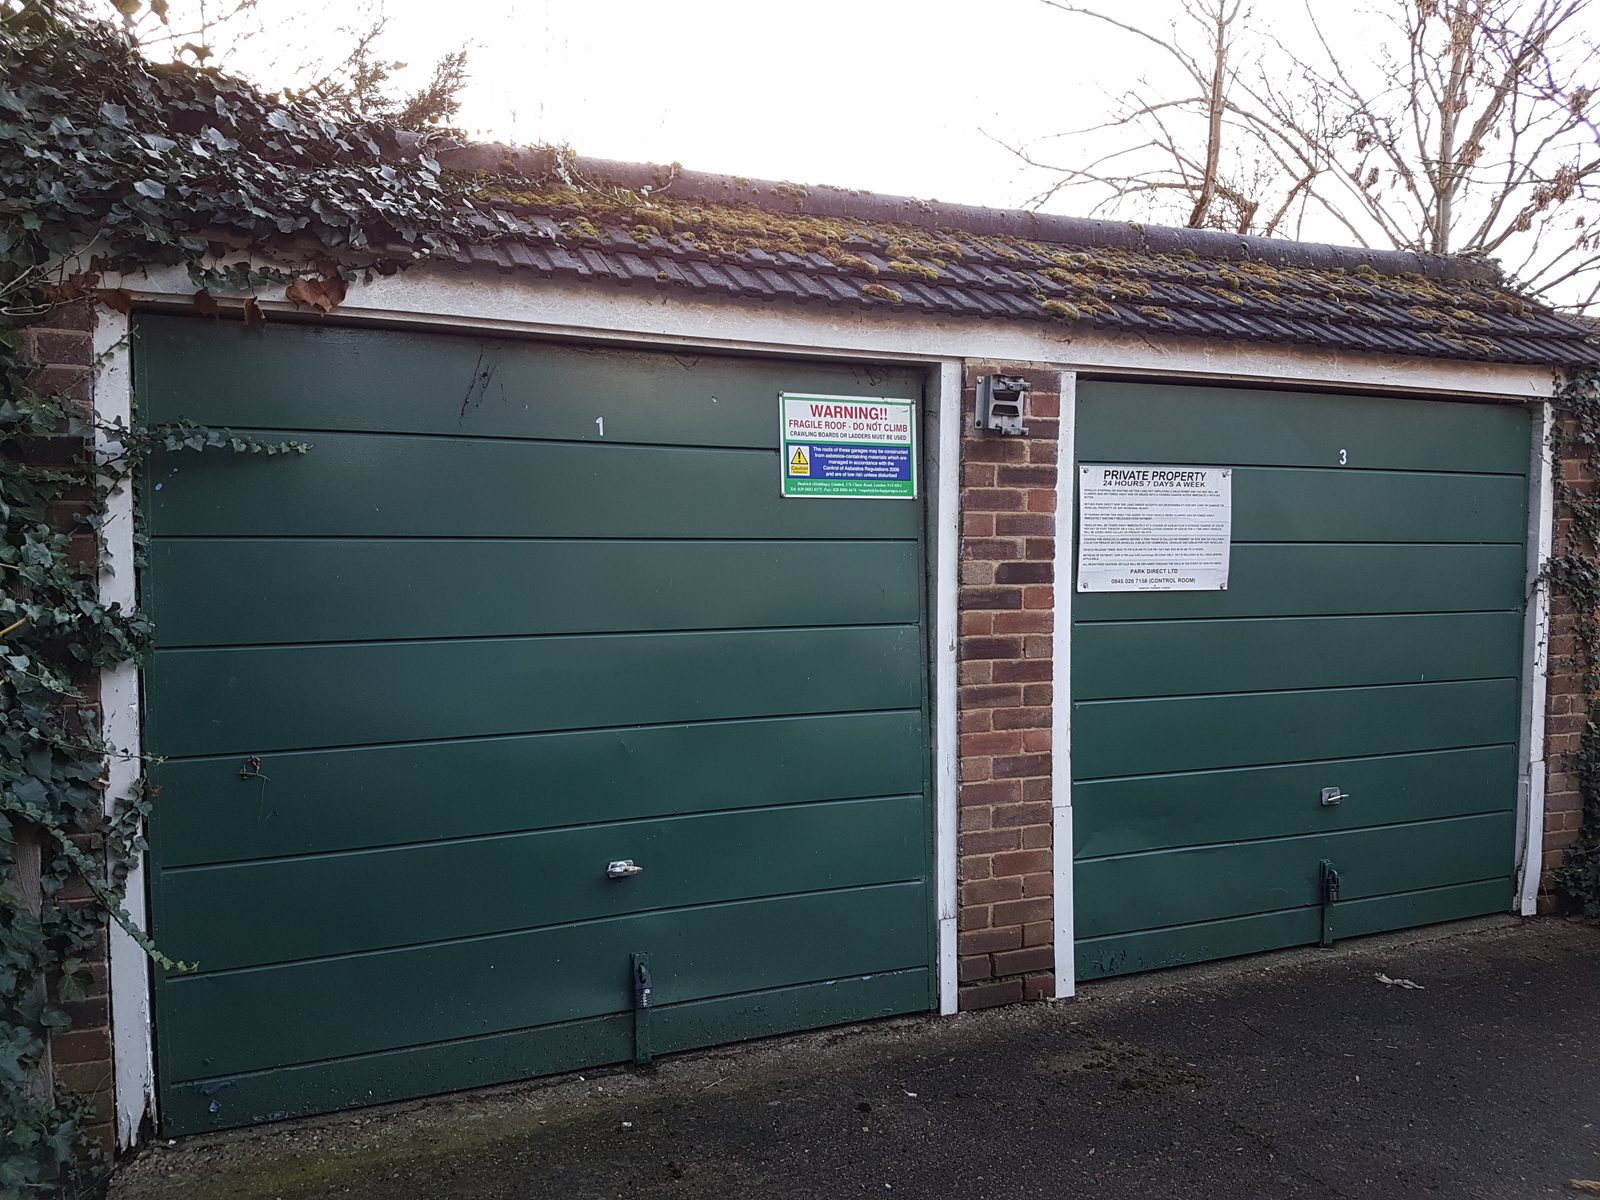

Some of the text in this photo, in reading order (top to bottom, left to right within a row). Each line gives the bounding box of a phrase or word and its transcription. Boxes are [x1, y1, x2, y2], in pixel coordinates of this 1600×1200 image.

[810, 404, 888, 420] WARNING!!
[596, 416, 603, 436] 1
[788, 420, 822, 429] FRAGILE
[825, 420, 846, 430] ROOF
[853, 422, 864, 431] DO
[866, 423, 882, 431] NOT
[884, 424, 907, 432] CLIMB
[1340, 449, 1347, 465] 3
[1103, 470, 1207, 481] PRIVATE PROPERTY
